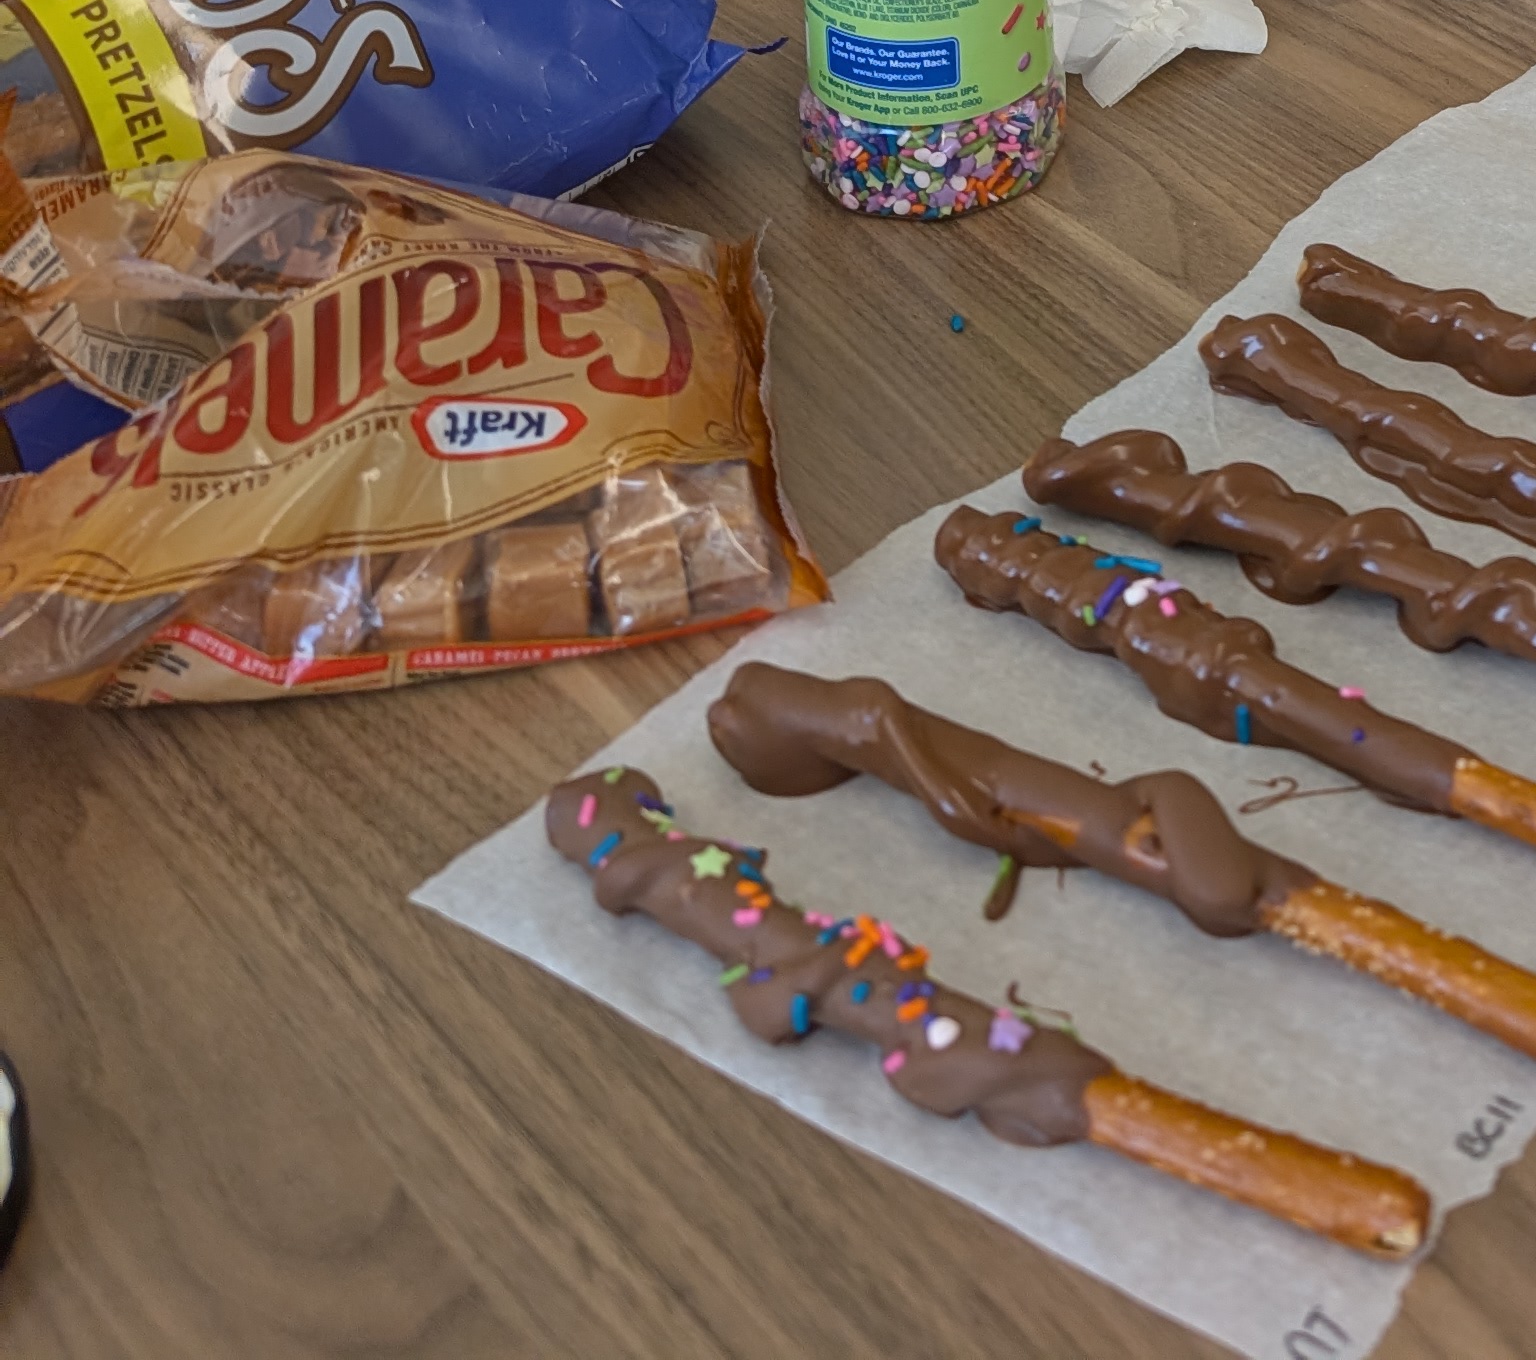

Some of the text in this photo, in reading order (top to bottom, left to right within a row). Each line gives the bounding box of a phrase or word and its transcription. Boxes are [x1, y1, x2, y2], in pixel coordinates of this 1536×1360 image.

[831, 36, 844, 48] Our
[845, 42, 876, 56] Brands.
[878, 48, 896, 58] Our
[832, 46, 849, 59] Love
[857, 56, 866, 64] or
[868, 57, 888, 67] Your
[889, 60, 922, 70] Money
[923, 58, 951, 68] Back.
[852, 66, 924, 82] www.kroger.com
[846, 82, 876, 99] Product
[935, 90, 958, 102] Scan
[960, 84, 979, 97] UPC
[846, 96, 872, 112] Kroger
[874, 104, 891, 116] App
[903, 105, 920, 116] Call
[444, 410, 547, 446] Kraft
[170, 471, 271, 503] CLASSIC
